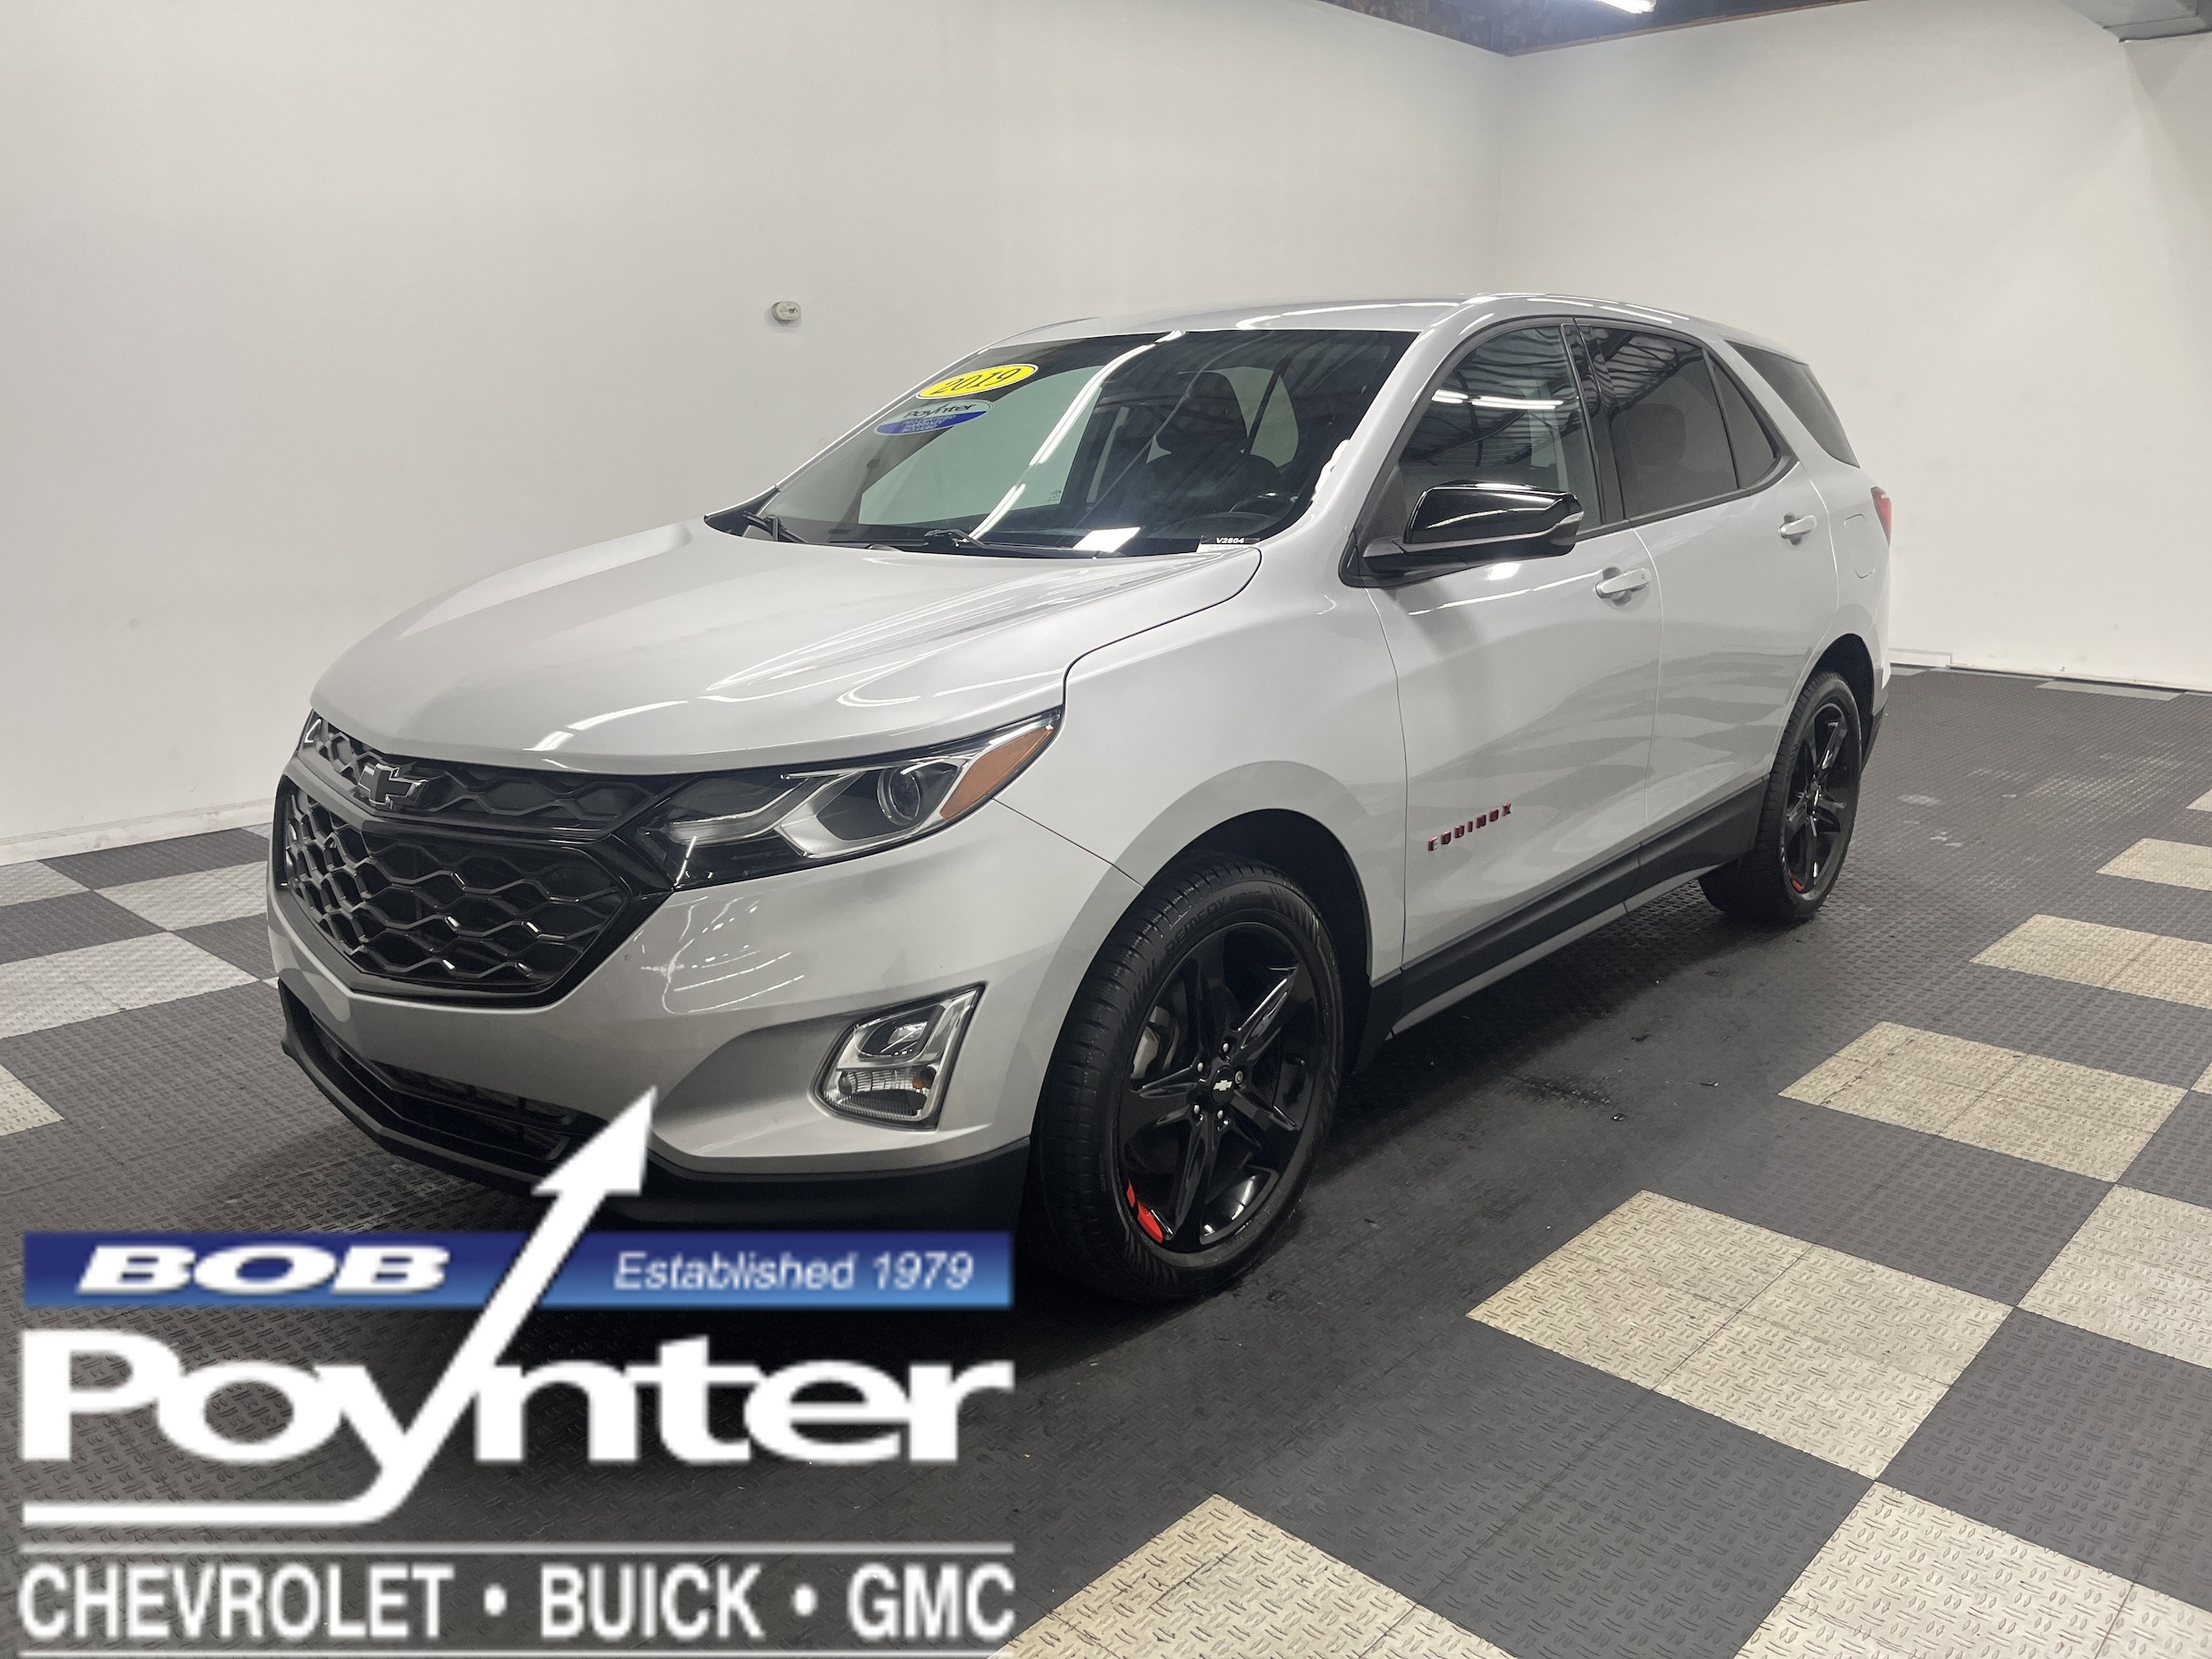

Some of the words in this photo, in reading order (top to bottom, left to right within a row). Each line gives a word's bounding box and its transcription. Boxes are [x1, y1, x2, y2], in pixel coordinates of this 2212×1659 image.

[929, 367, 1022, 395] 2019
[902, 403, 976, 419] Poynter
[1428, 802, 1512, 851] EQUINOX
